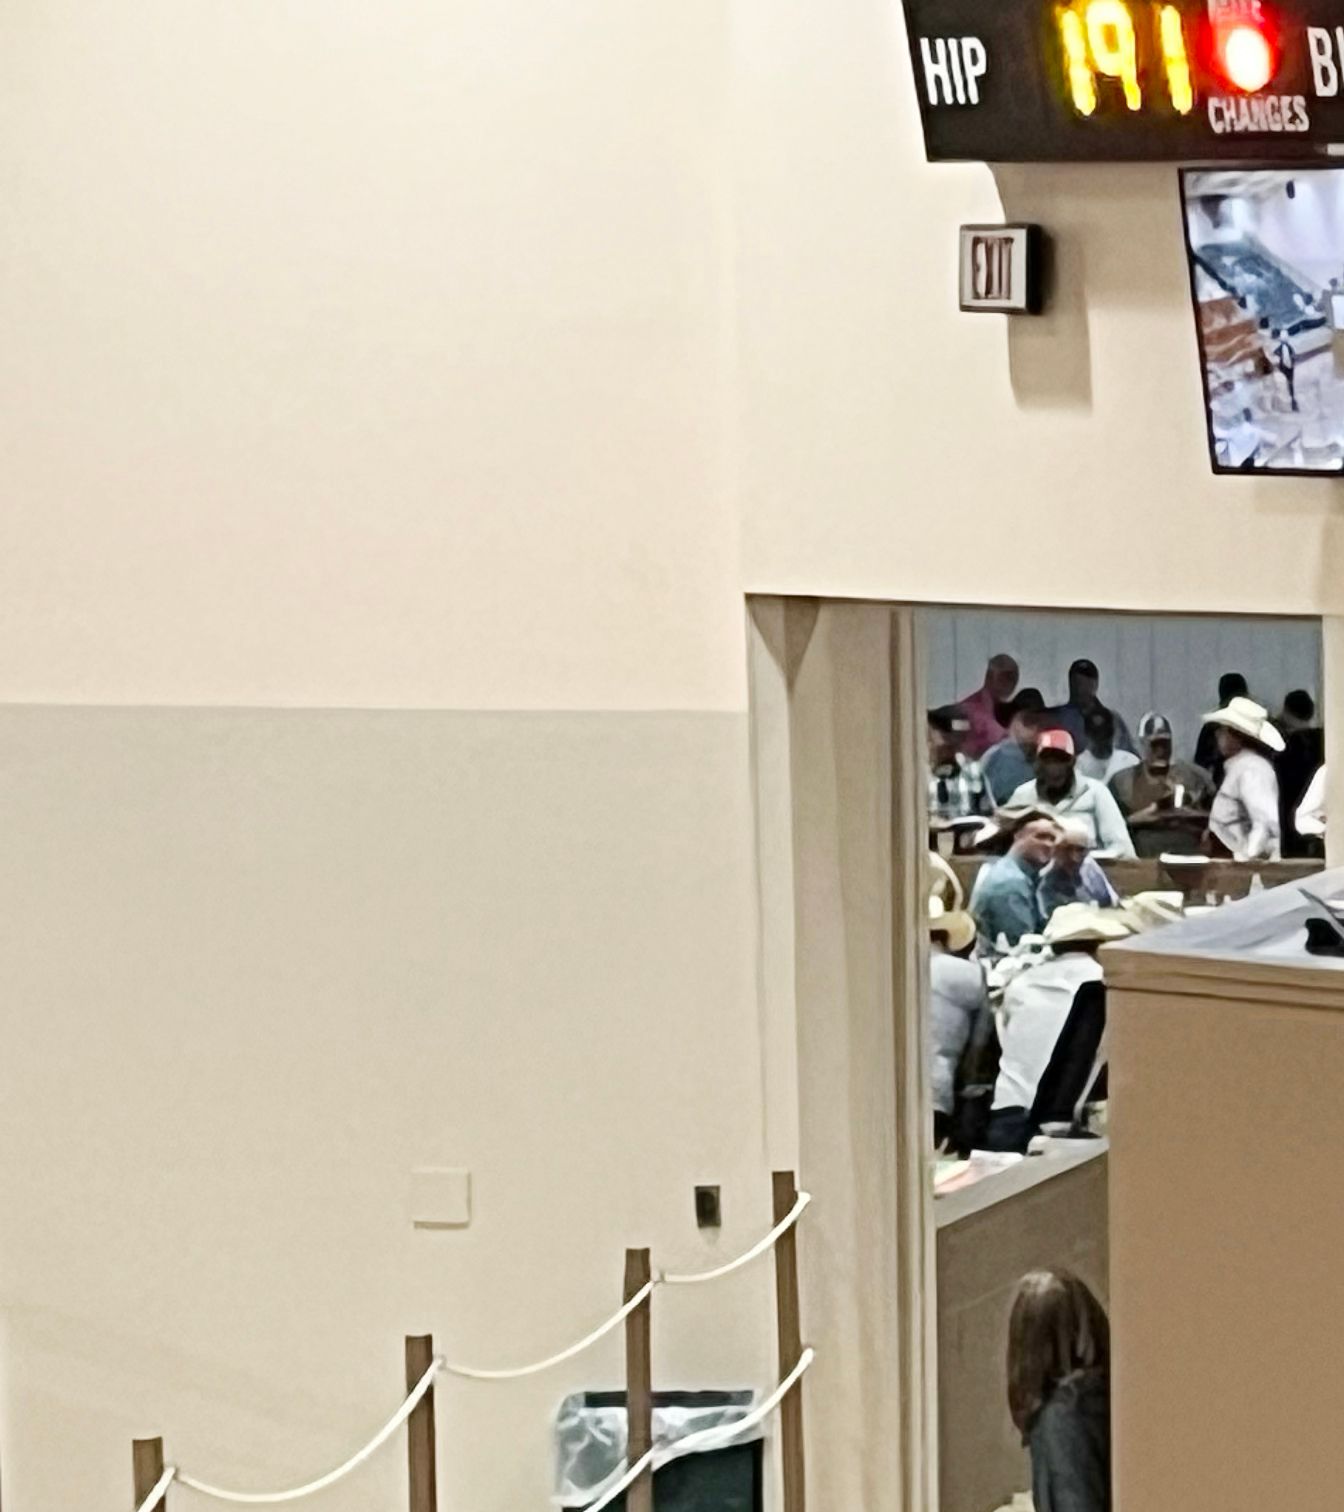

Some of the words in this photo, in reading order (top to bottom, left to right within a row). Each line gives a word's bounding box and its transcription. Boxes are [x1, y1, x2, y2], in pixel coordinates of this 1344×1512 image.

[920, 36, 987, 105] HIP
[1058, 0, 1193, 116] 191
[1207, 95, 1309, 134] CHANGES
